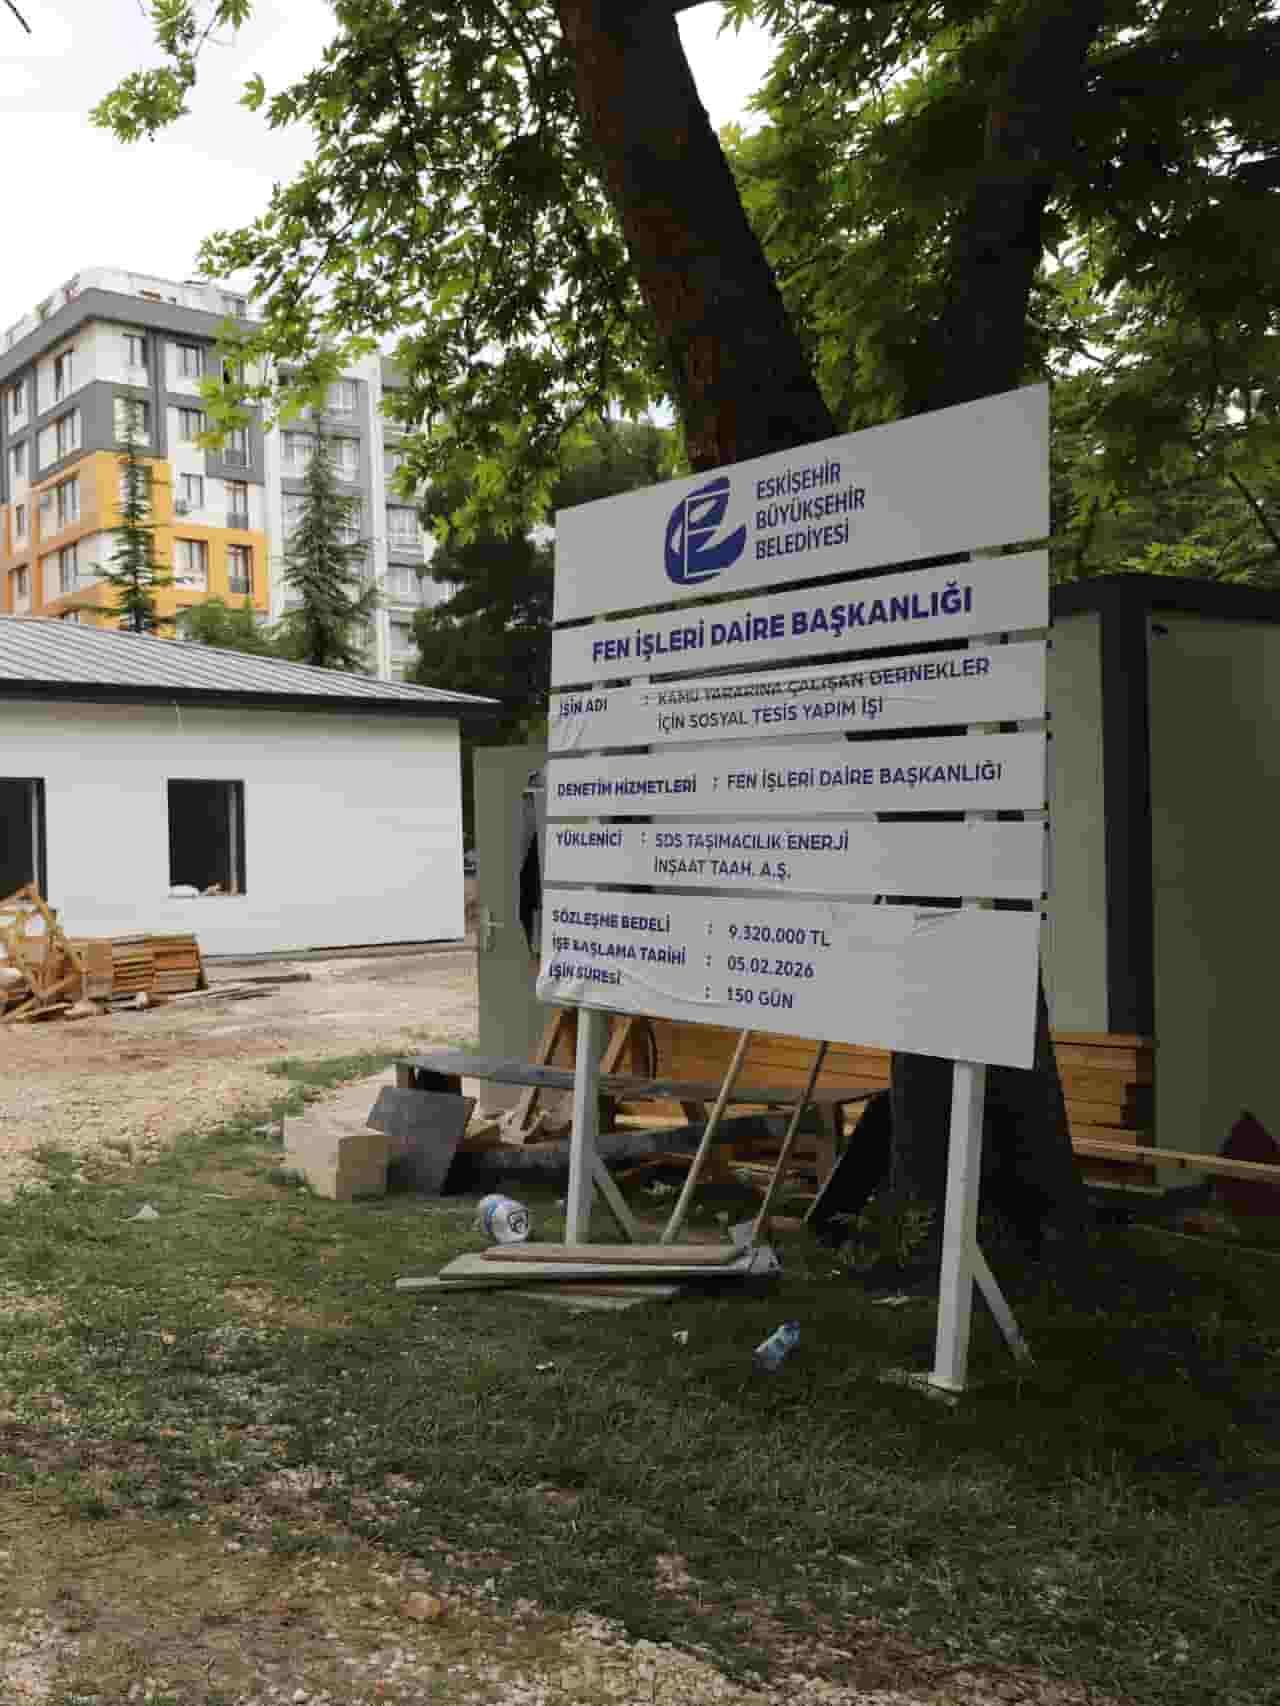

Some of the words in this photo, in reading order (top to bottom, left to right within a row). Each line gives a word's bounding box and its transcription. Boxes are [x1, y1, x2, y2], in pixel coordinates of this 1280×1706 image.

[756, 456, 841, 500] ESKİŞEHİR
[756, 484, 866, 530] BÜYÜKŞEHİR
[755, 517, 849, 560] BELEDİYESİ
[592, 639, 630, 662] FEN
[635, 619, 705, 662] İŞLERİ
[711, 606, 785, 647] DAİRE
[791, 581, 973, 637] BAŞKANLIĞI
[585, 696, 608, 713] ADI
[658, 712, 686, 734] İÇİN
[688, 711, 748, 729] SOSYAL
[752, 702, 798, 723] TESİS
[802, 700, 856, 719] YAPIM
[862, 695, 883, 720] İŞİ
[557, 776, 612, 797] DENETİM
[615, 773, 697, 795] HİZMETLERİ
[727, 773, 757, 790] FEN
[762, 766, 815, 792] İŞLERİ
[819, 761, 874, 786] DAİRE
[879, 760, 1002, 789] BAŞKANLIĞI
[556, 827, 624, 847] YÜKLENİCİ
[655, 832, 682, 848] SDS
[687, 832, 781, 852] TAŞIMACILIK
[787, 828, 849, 851] ENERJİ
[653, 856, 706, 877] İNŞAAT
[711, 859, 755, 877] TAAH.
[759, 861, 791, 881] A.Ş.
[551, 906, 619, 930] SÖZLEŞME
[621, 912, 671, 933] BEDELİ
[728, 923, 806, 945] 9.320.000
[810, 929, 832, 947] TL
[639, 945, 688, 966] TARİHİ
[727, 955, 814, 978] 05.02.2026
[727, 985, 754, 1004] 150
[758, 987, 794, 1009] GÜN
